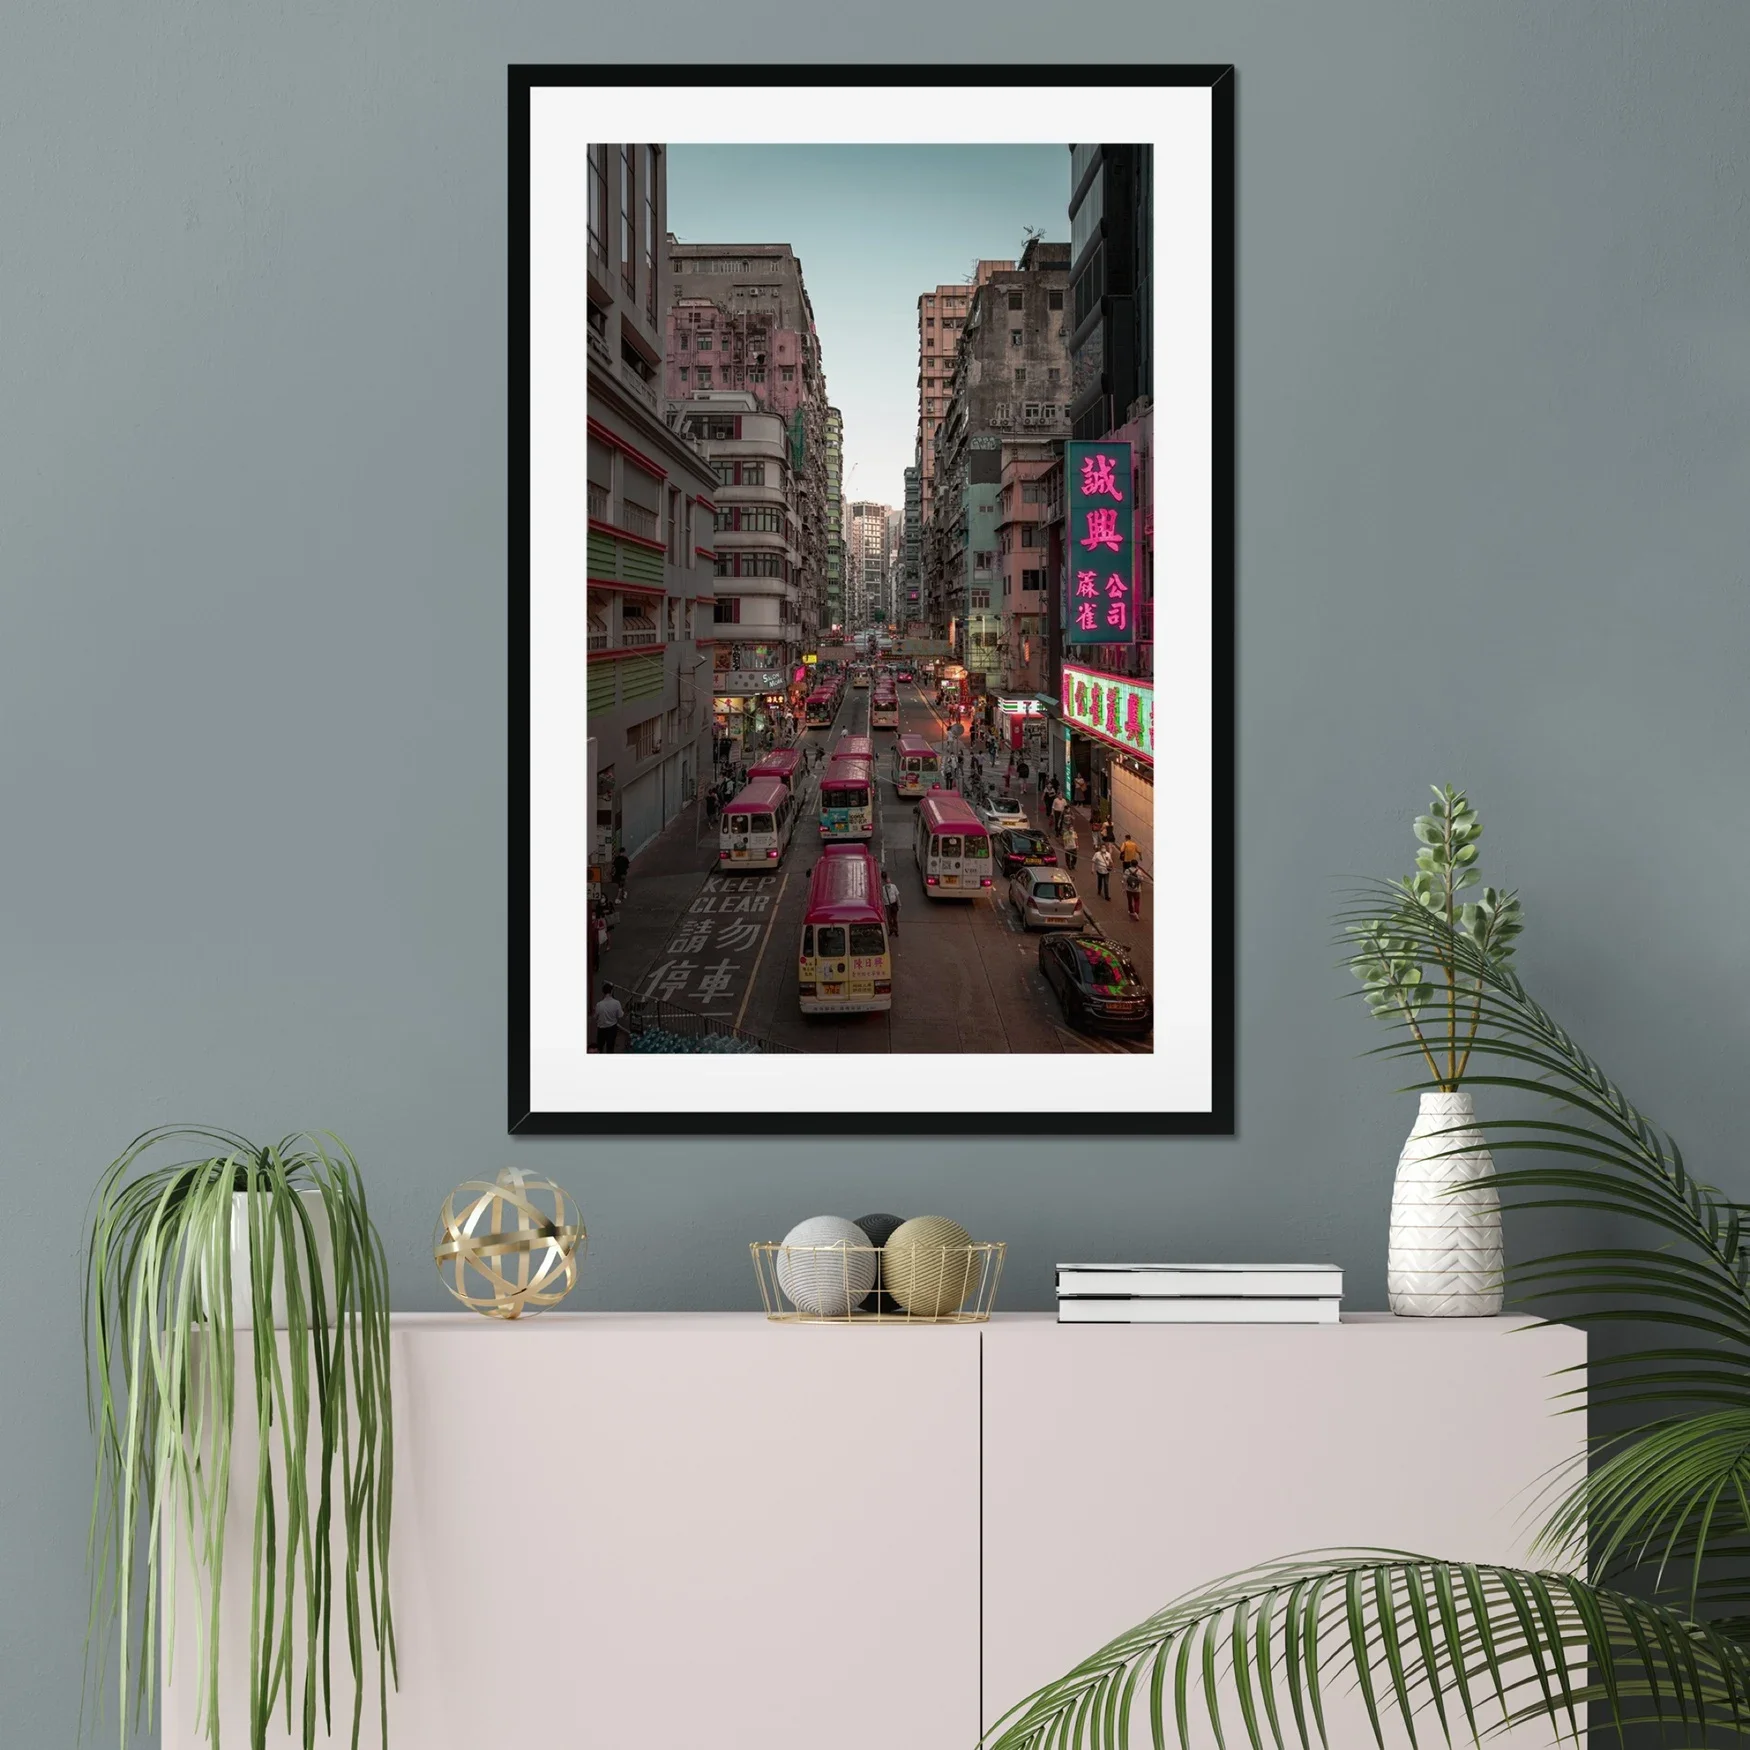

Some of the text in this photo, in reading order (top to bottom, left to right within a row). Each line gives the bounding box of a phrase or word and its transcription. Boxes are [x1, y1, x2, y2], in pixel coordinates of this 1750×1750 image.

[1080, 454, 1124, 552] 誠興
[1104, 572, 1129, 631] 公司
[688, 896, 770, 914] CLEAR
[702, 876, 777, 893] KEEP
[667, 917, 762, 954] 請勿
[642, 958, 741, 1003] 停車
